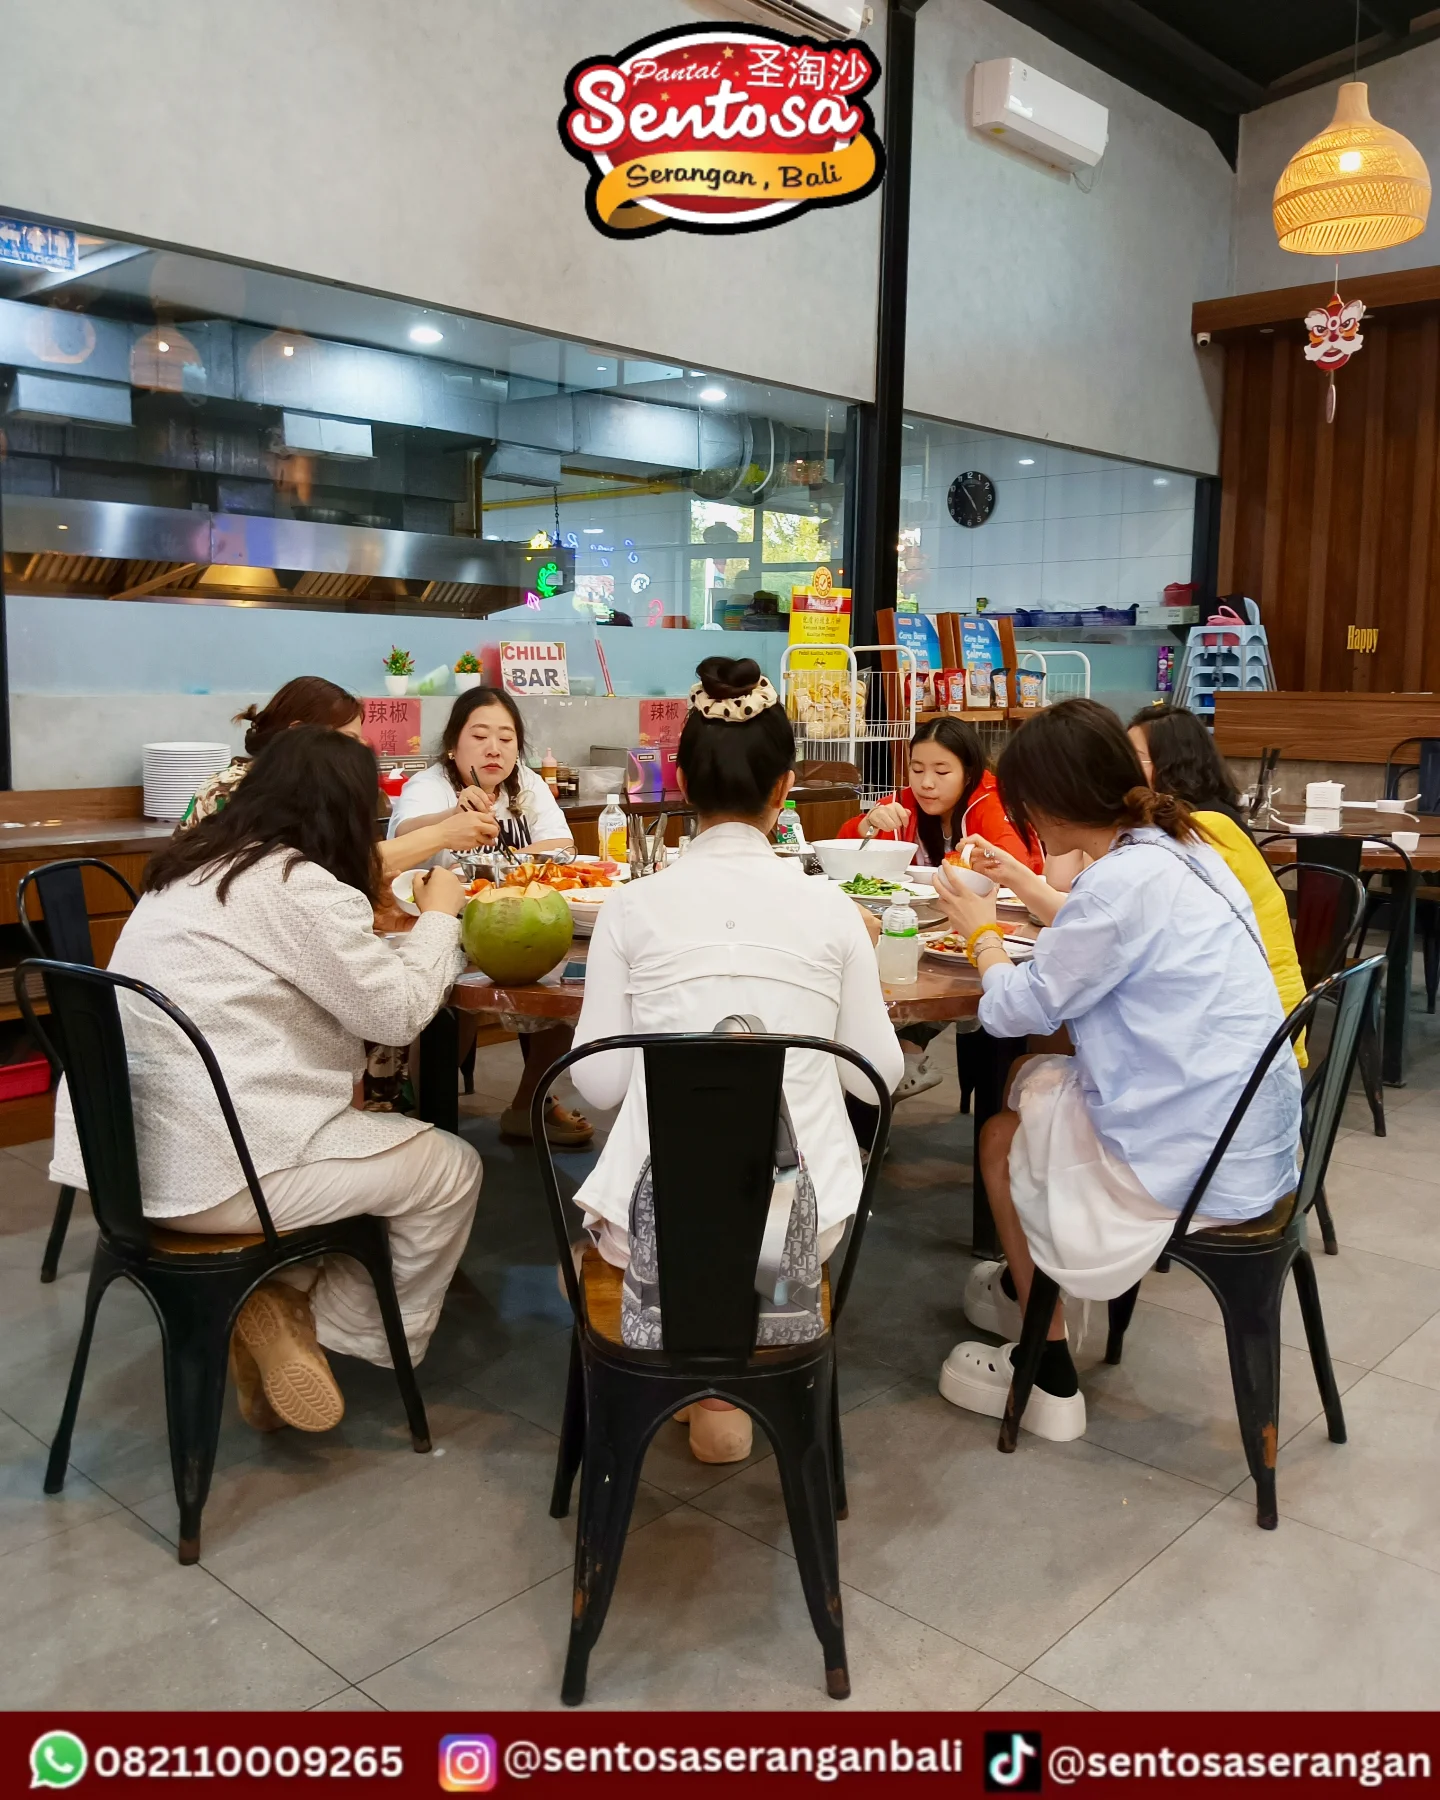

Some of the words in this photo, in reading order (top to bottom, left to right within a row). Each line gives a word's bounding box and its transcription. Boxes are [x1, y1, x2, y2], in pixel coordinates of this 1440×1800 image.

[1346, 624, 1379, 653] Happy
[503, 645, 562, 660] CHILLI
[966, 648, 992, 660] Salmon
[511, 668, 560, 687] BAR
[368, 701, 408, 723] 辣椒
[650, 702, 679, 721] 辣椒
